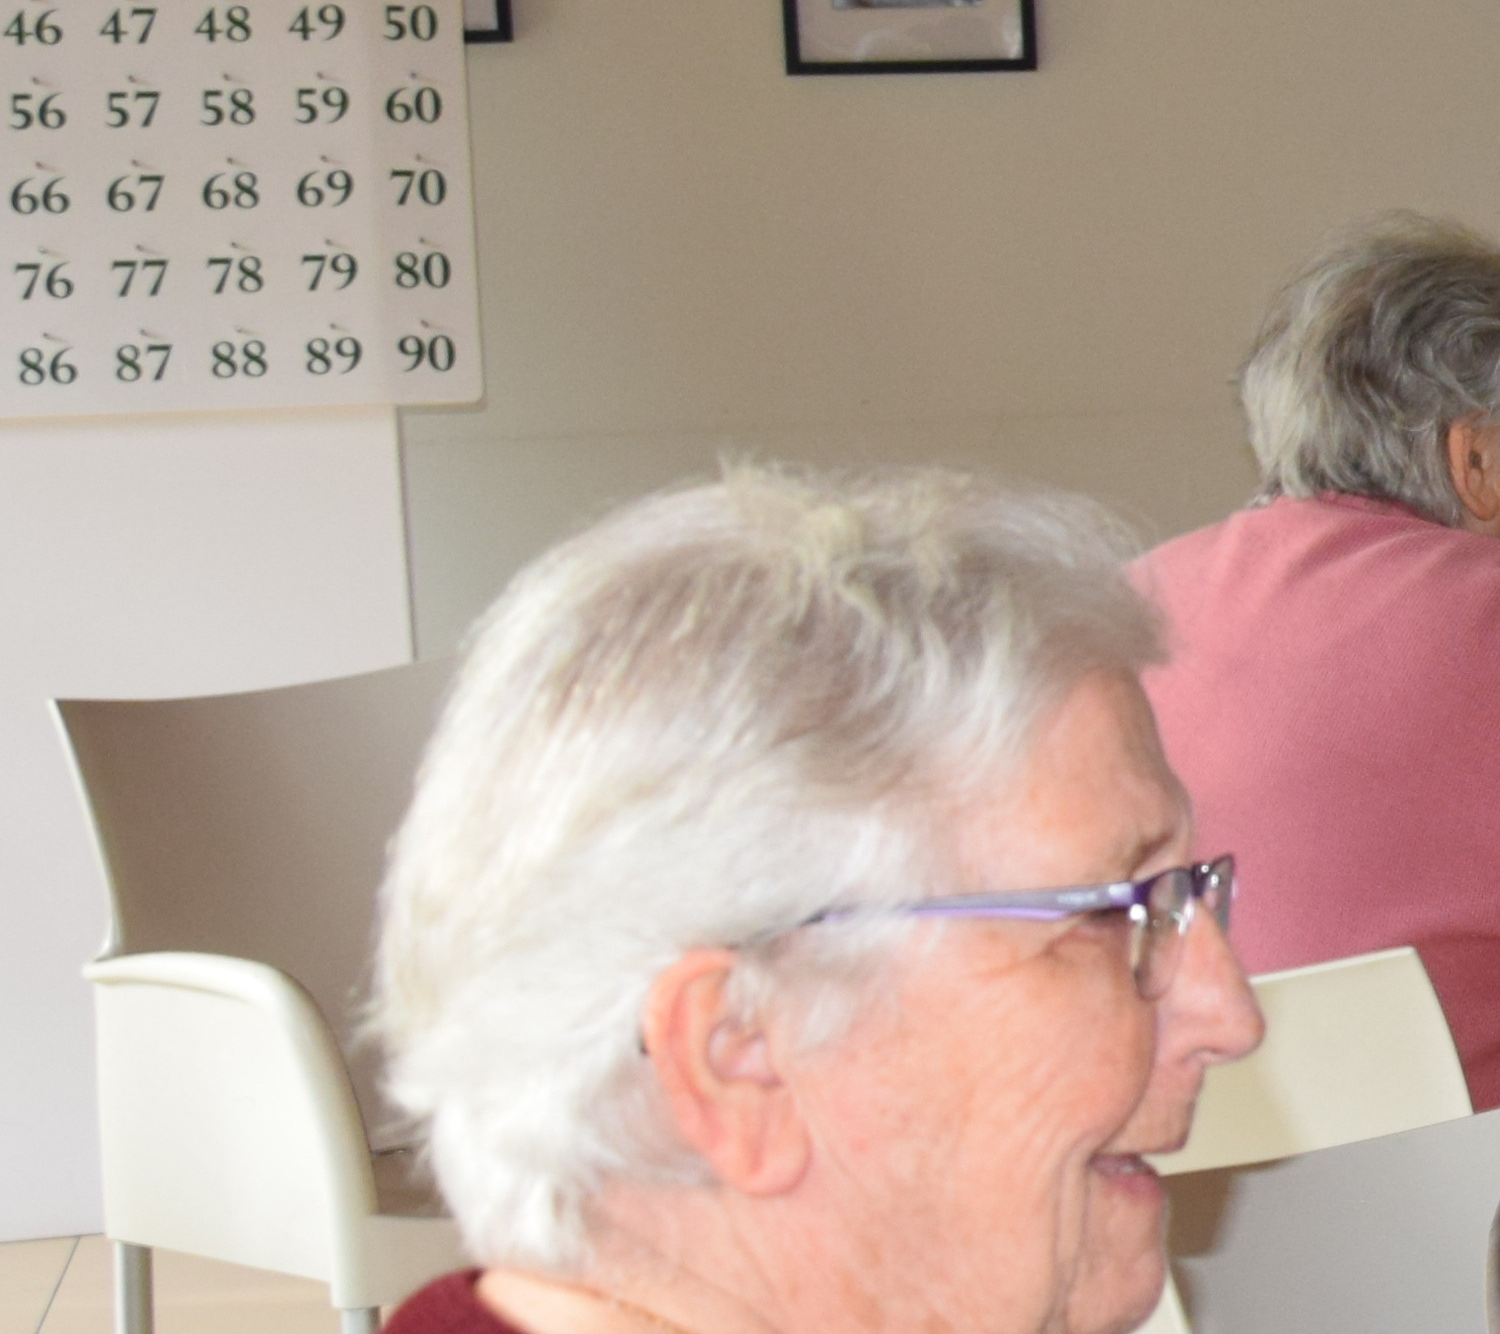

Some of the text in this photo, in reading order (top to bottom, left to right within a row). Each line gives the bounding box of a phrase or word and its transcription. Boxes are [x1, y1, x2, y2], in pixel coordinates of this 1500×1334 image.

[3, 4, 439, 46] 46 47 48 49 50
[11, 86, 443, 131] 56 57 58 59 60
[9, 169, 447, 215] 66 67 68 69 70
[14, 251, 452, 301] 76 77 78 79 80
[19, 334, 456, 385] 86 87 88 89 90
